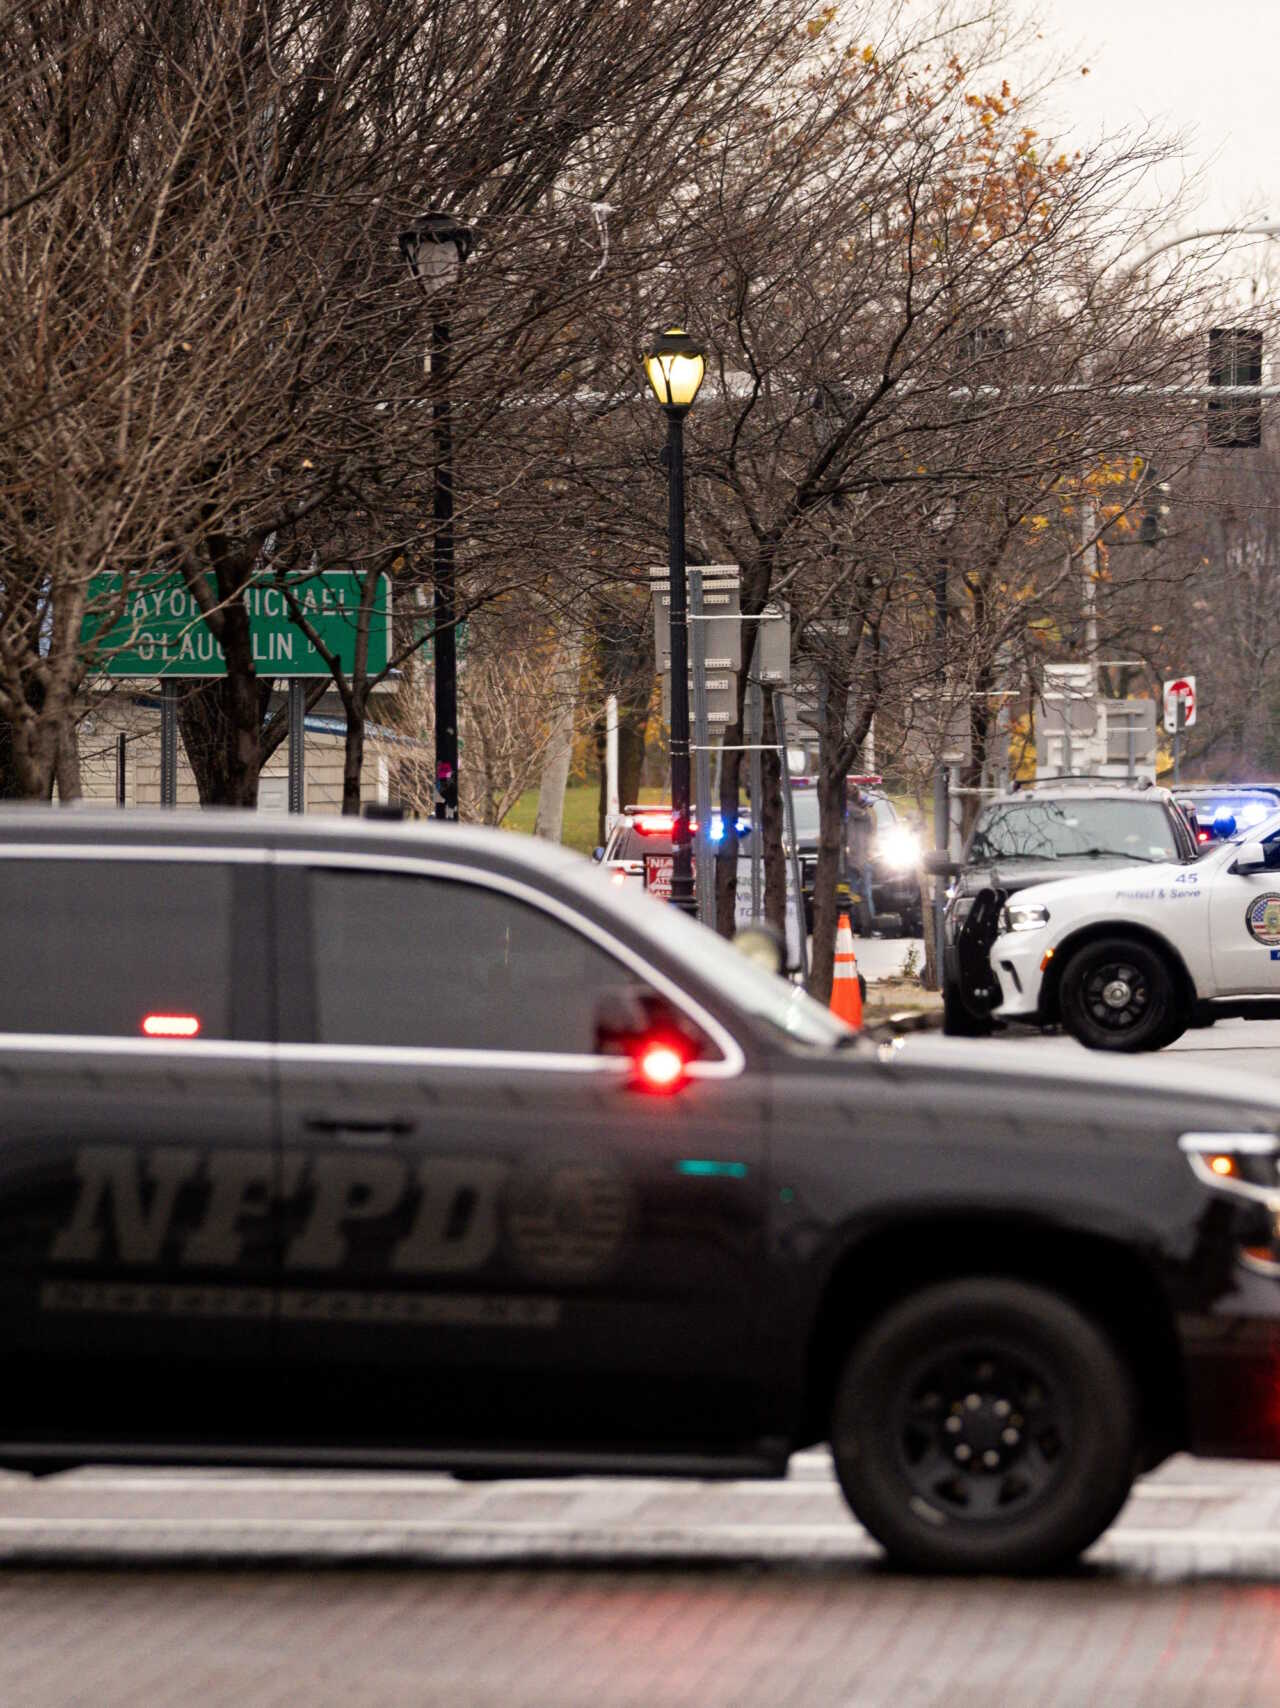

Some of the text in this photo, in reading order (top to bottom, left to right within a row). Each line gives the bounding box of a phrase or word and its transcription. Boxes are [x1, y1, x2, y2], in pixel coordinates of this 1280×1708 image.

[1176, 873, 1199, 884] 45
[1158, 889, 1165, 898] &
[1169, 888, 1201, 899] Serve
[50, 1145, 510, 1272] NFPD
